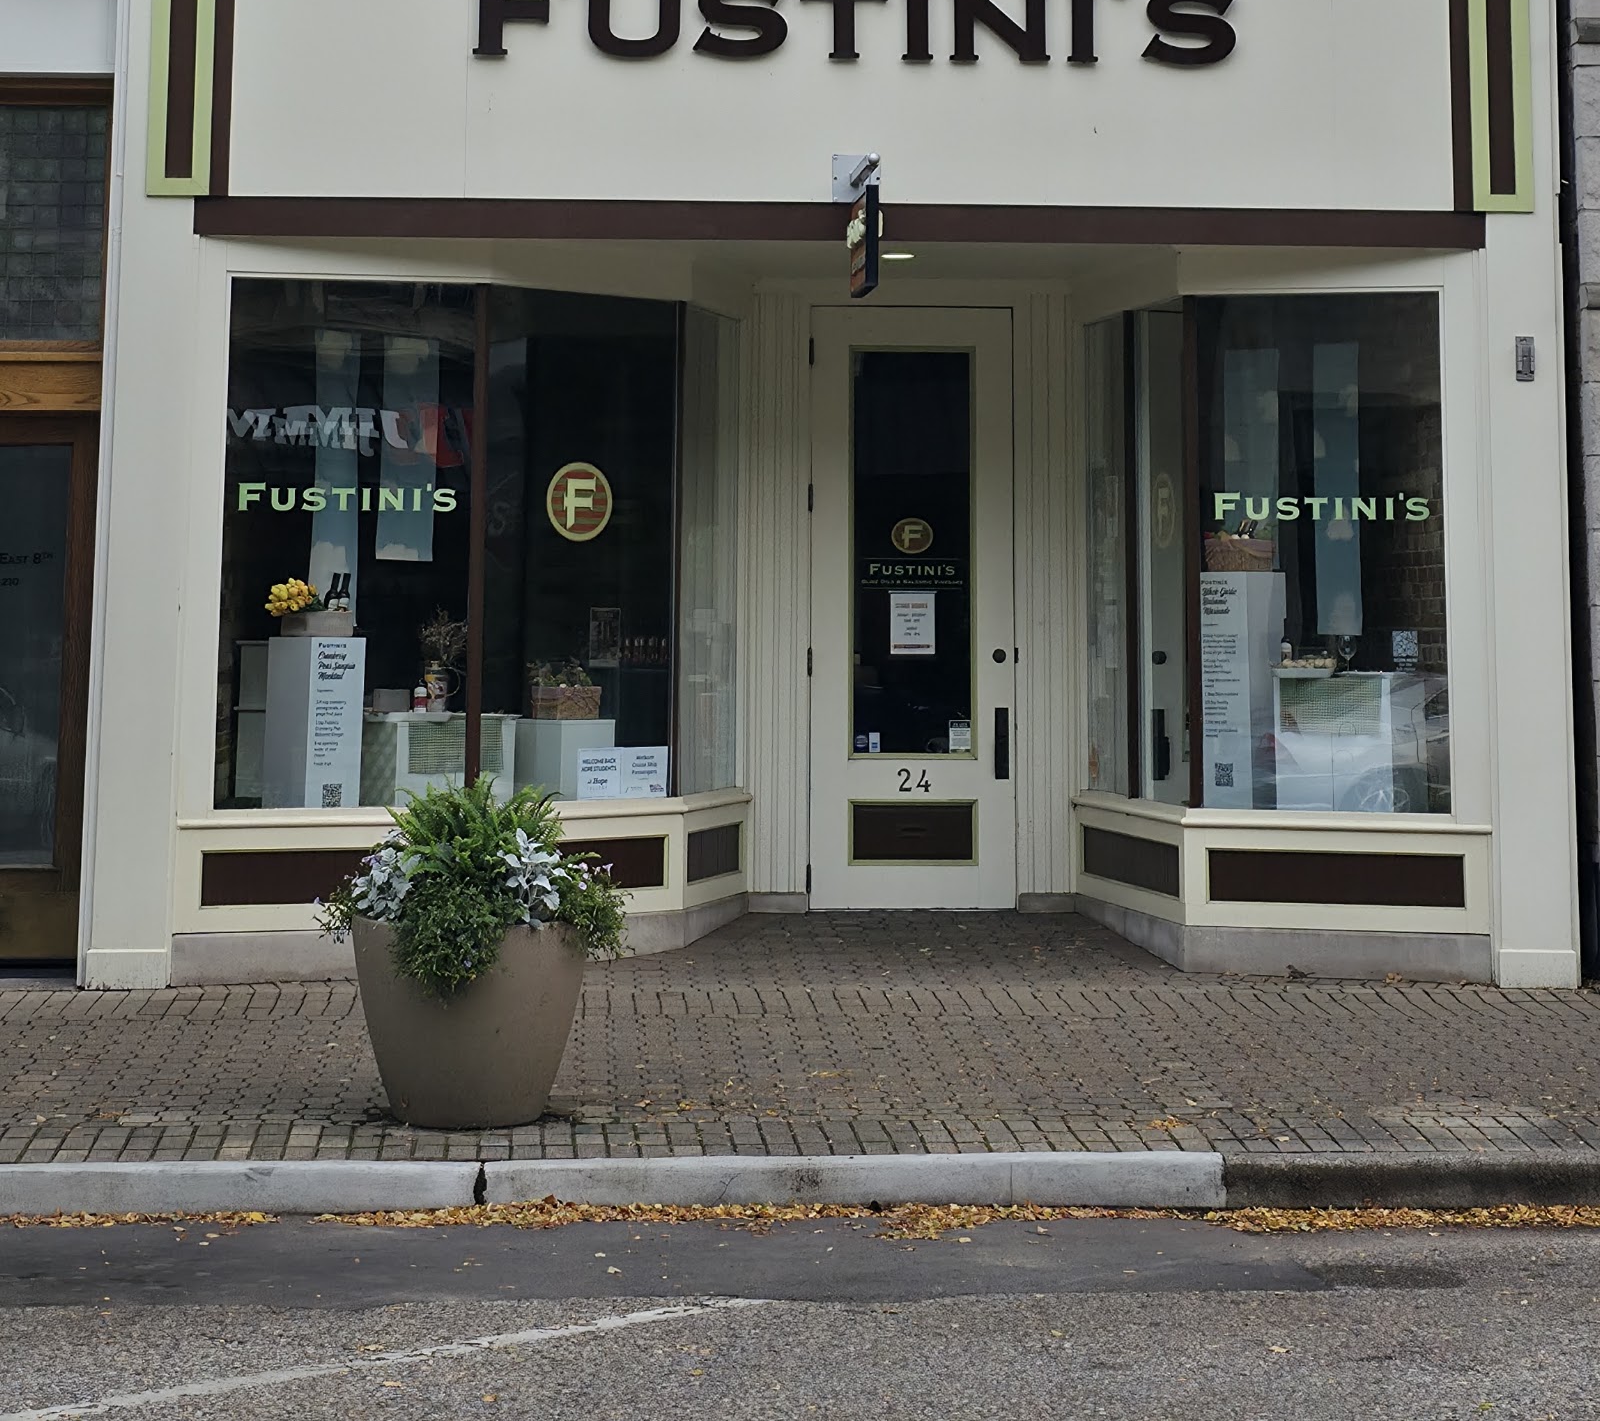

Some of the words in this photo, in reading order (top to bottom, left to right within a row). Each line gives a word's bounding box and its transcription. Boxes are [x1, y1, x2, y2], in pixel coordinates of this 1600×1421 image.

[237, 481, 458, 513] FUSTINI'S
[1213, 491, 1432, 522] FUSTINI'S
[869, 563, 955, 576] FUSTINI'S
[897, 767, 932, 793] 24
